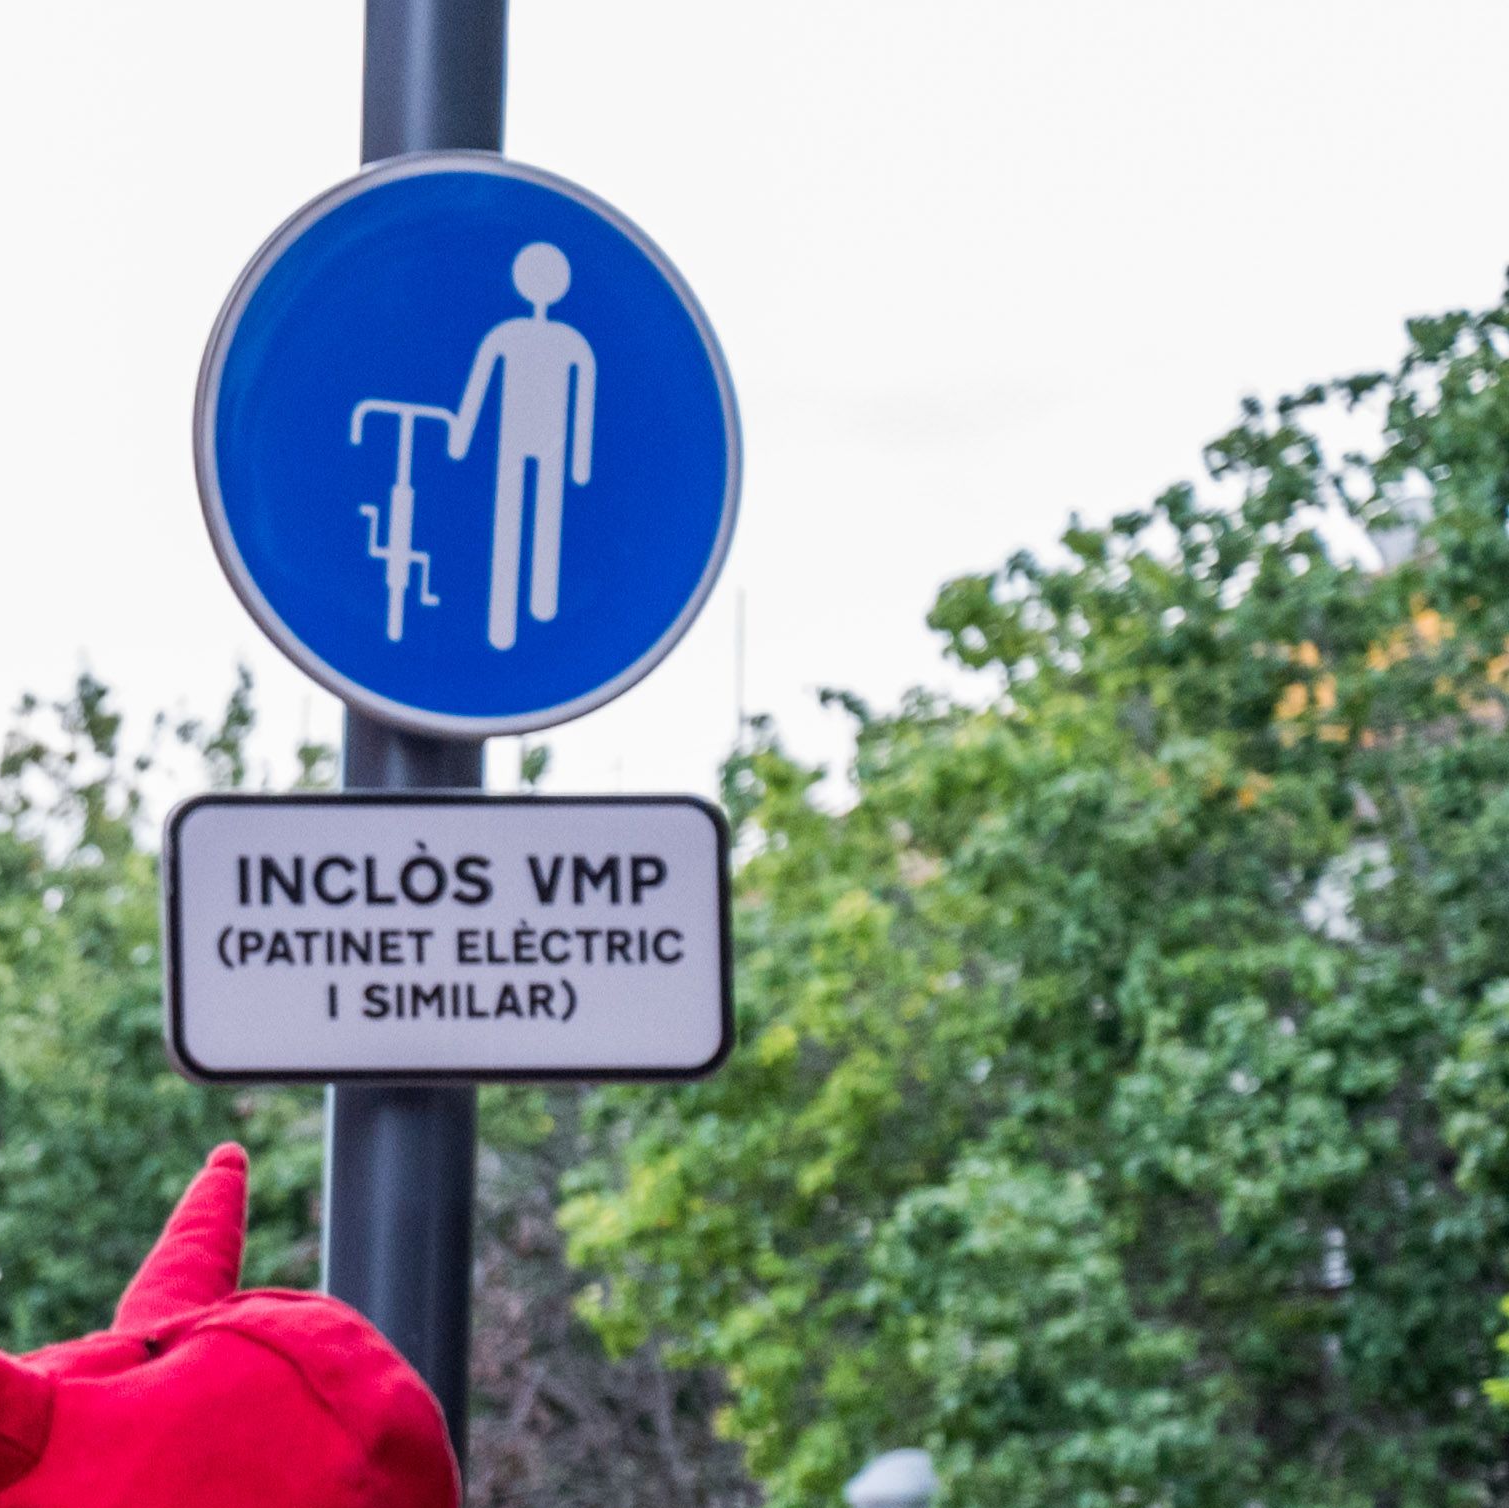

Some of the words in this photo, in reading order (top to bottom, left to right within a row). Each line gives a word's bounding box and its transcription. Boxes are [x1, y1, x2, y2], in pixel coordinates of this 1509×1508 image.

[237, 841, 493, 905] INCLÒS
[527, 856, 667, 904] VMP
[218, 926, 433, 968] (PATINET
[457, 921, 684, 964] ELÈCTRIC
[328, 984, 338, 1018] I
[363, 980, 578, 1021] SIMILAR)
